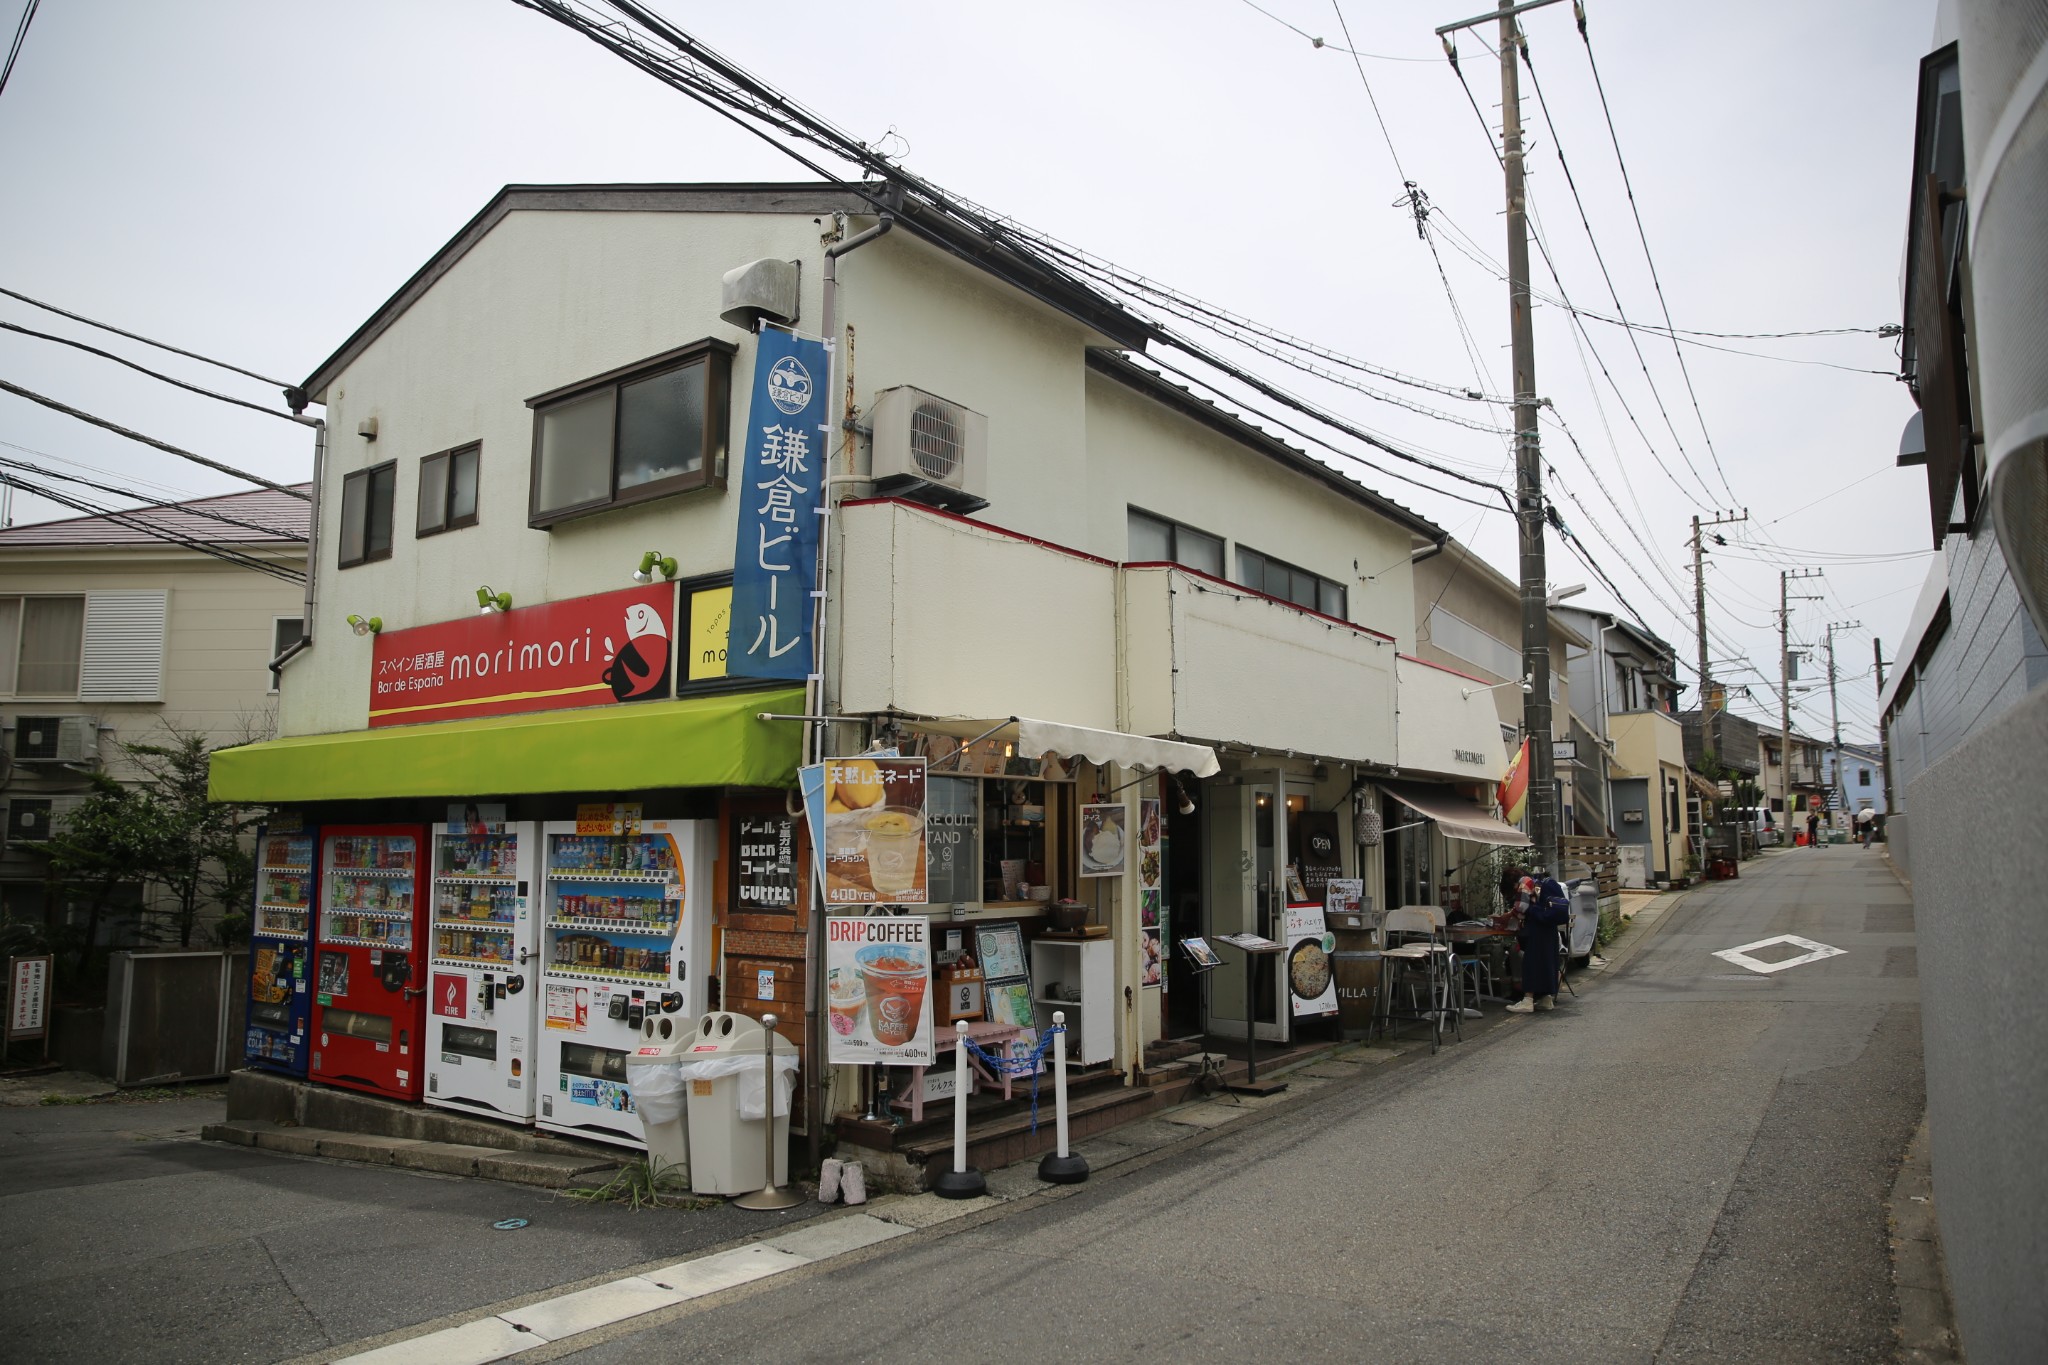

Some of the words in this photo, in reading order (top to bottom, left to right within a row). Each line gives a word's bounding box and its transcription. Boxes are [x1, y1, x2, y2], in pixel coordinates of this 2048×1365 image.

[772, 386, 807, 403] 鎌倉ビール
[747, 423, 810, 659] 鎌倉ビール
[450, 627, 591, 681] morimori
[379, 650, 445, 676] スペイン居酒屋
[378, 680, 393, 694] Bar
[394, 678, 406, 691] de
[408, 672, 444, 693] España
[1455, 748, 1486, 765] MORIMORI
[927, 813, 943, 826] KE
[944, 813, 971, 826] OUT
[927, 831, 961, 844] TAND
[1312, 837, 1331, 850] OPEN
[830, 888, 857, 901] 400
[857, 891, 876, 901] YEN
[867, 923, 923, 943] COFFEE
[444, 1005, 459, 1016] FIRE
[904, 1048, 918, 1058] 400
